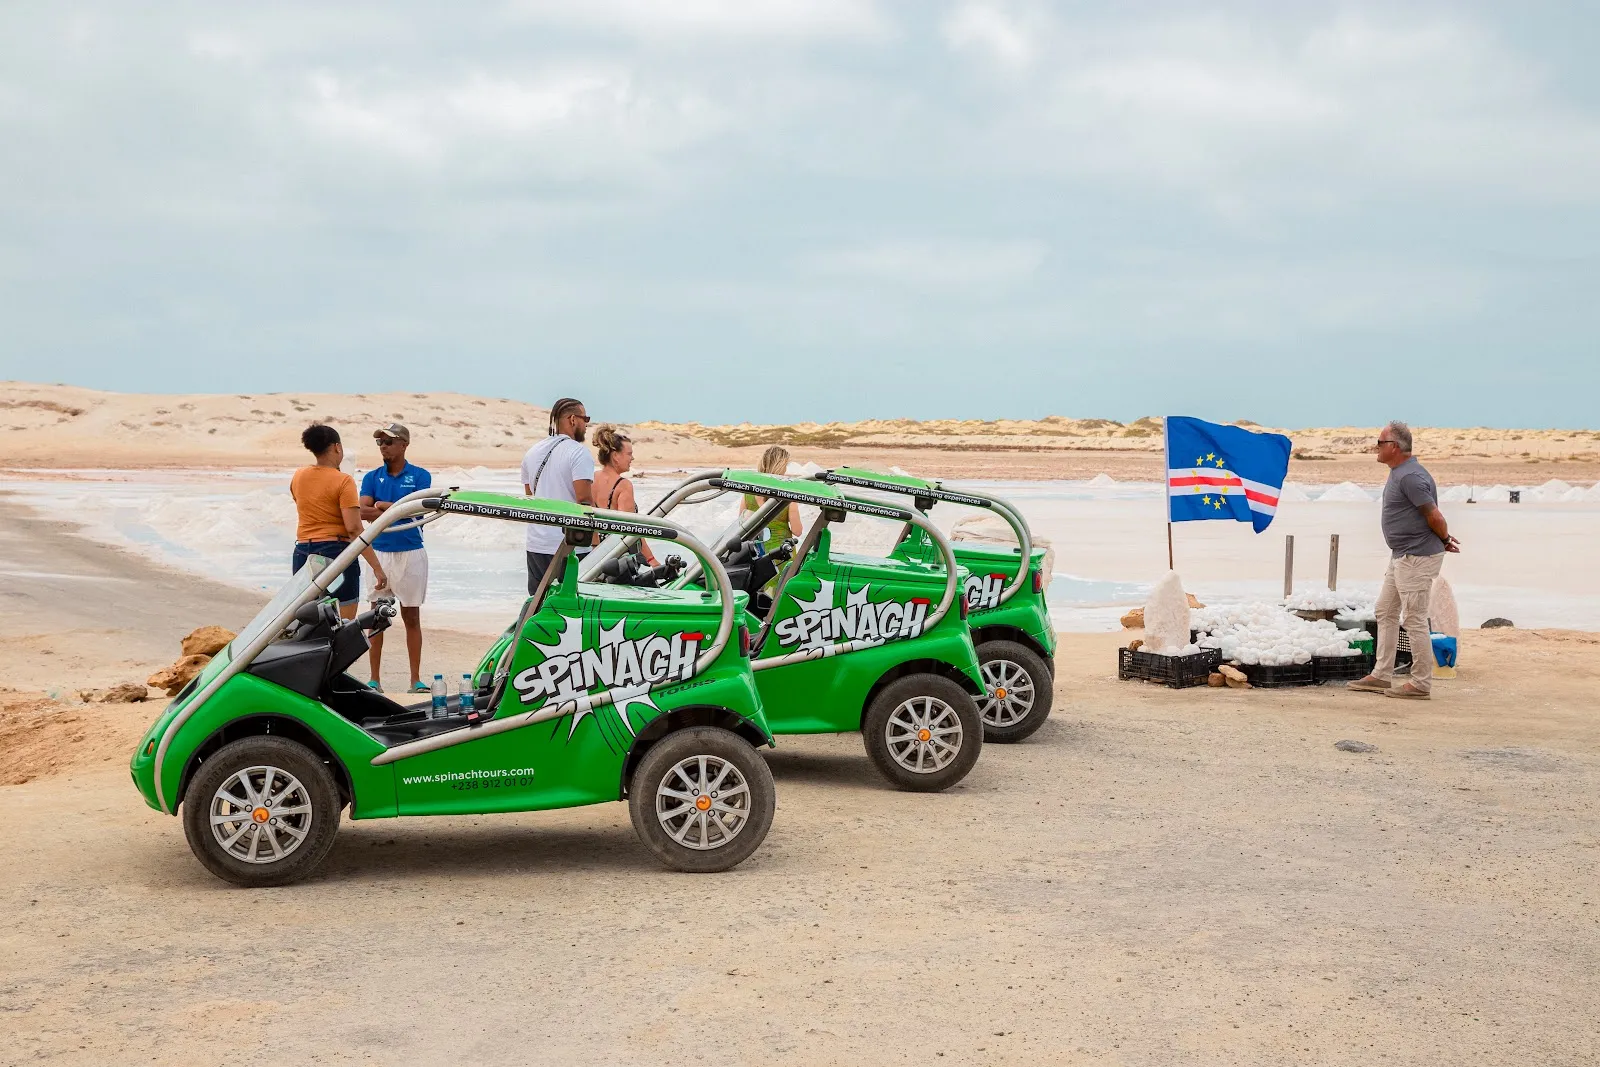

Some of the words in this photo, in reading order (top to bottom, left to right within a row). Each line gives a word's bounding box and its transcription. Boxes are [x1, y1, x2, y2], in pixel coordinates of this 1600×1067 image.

[752, 485, 771, 495] Tours
[777, 490, 815, 503] Interactive
[858, 503, 900, 518] experiences
[852, 477, 869, 486] Tours
[874, 481, 906, 493] Interactive
[944, 493, 981, 505] experiences
[476, 505, 501, 515] Tours
[509, 510, 556, 523] Interactive
[558, 516, 608, 530] sightseing
[610, 524, 662, 536] experiences
[403, 767, 534, 784] www.spinachtours.com
[452, 780, 479, 791] +238
[482, 779, 501, 789] 912
[504, 778, 517, 787] 01
[520, 777, 534, 787] 07
